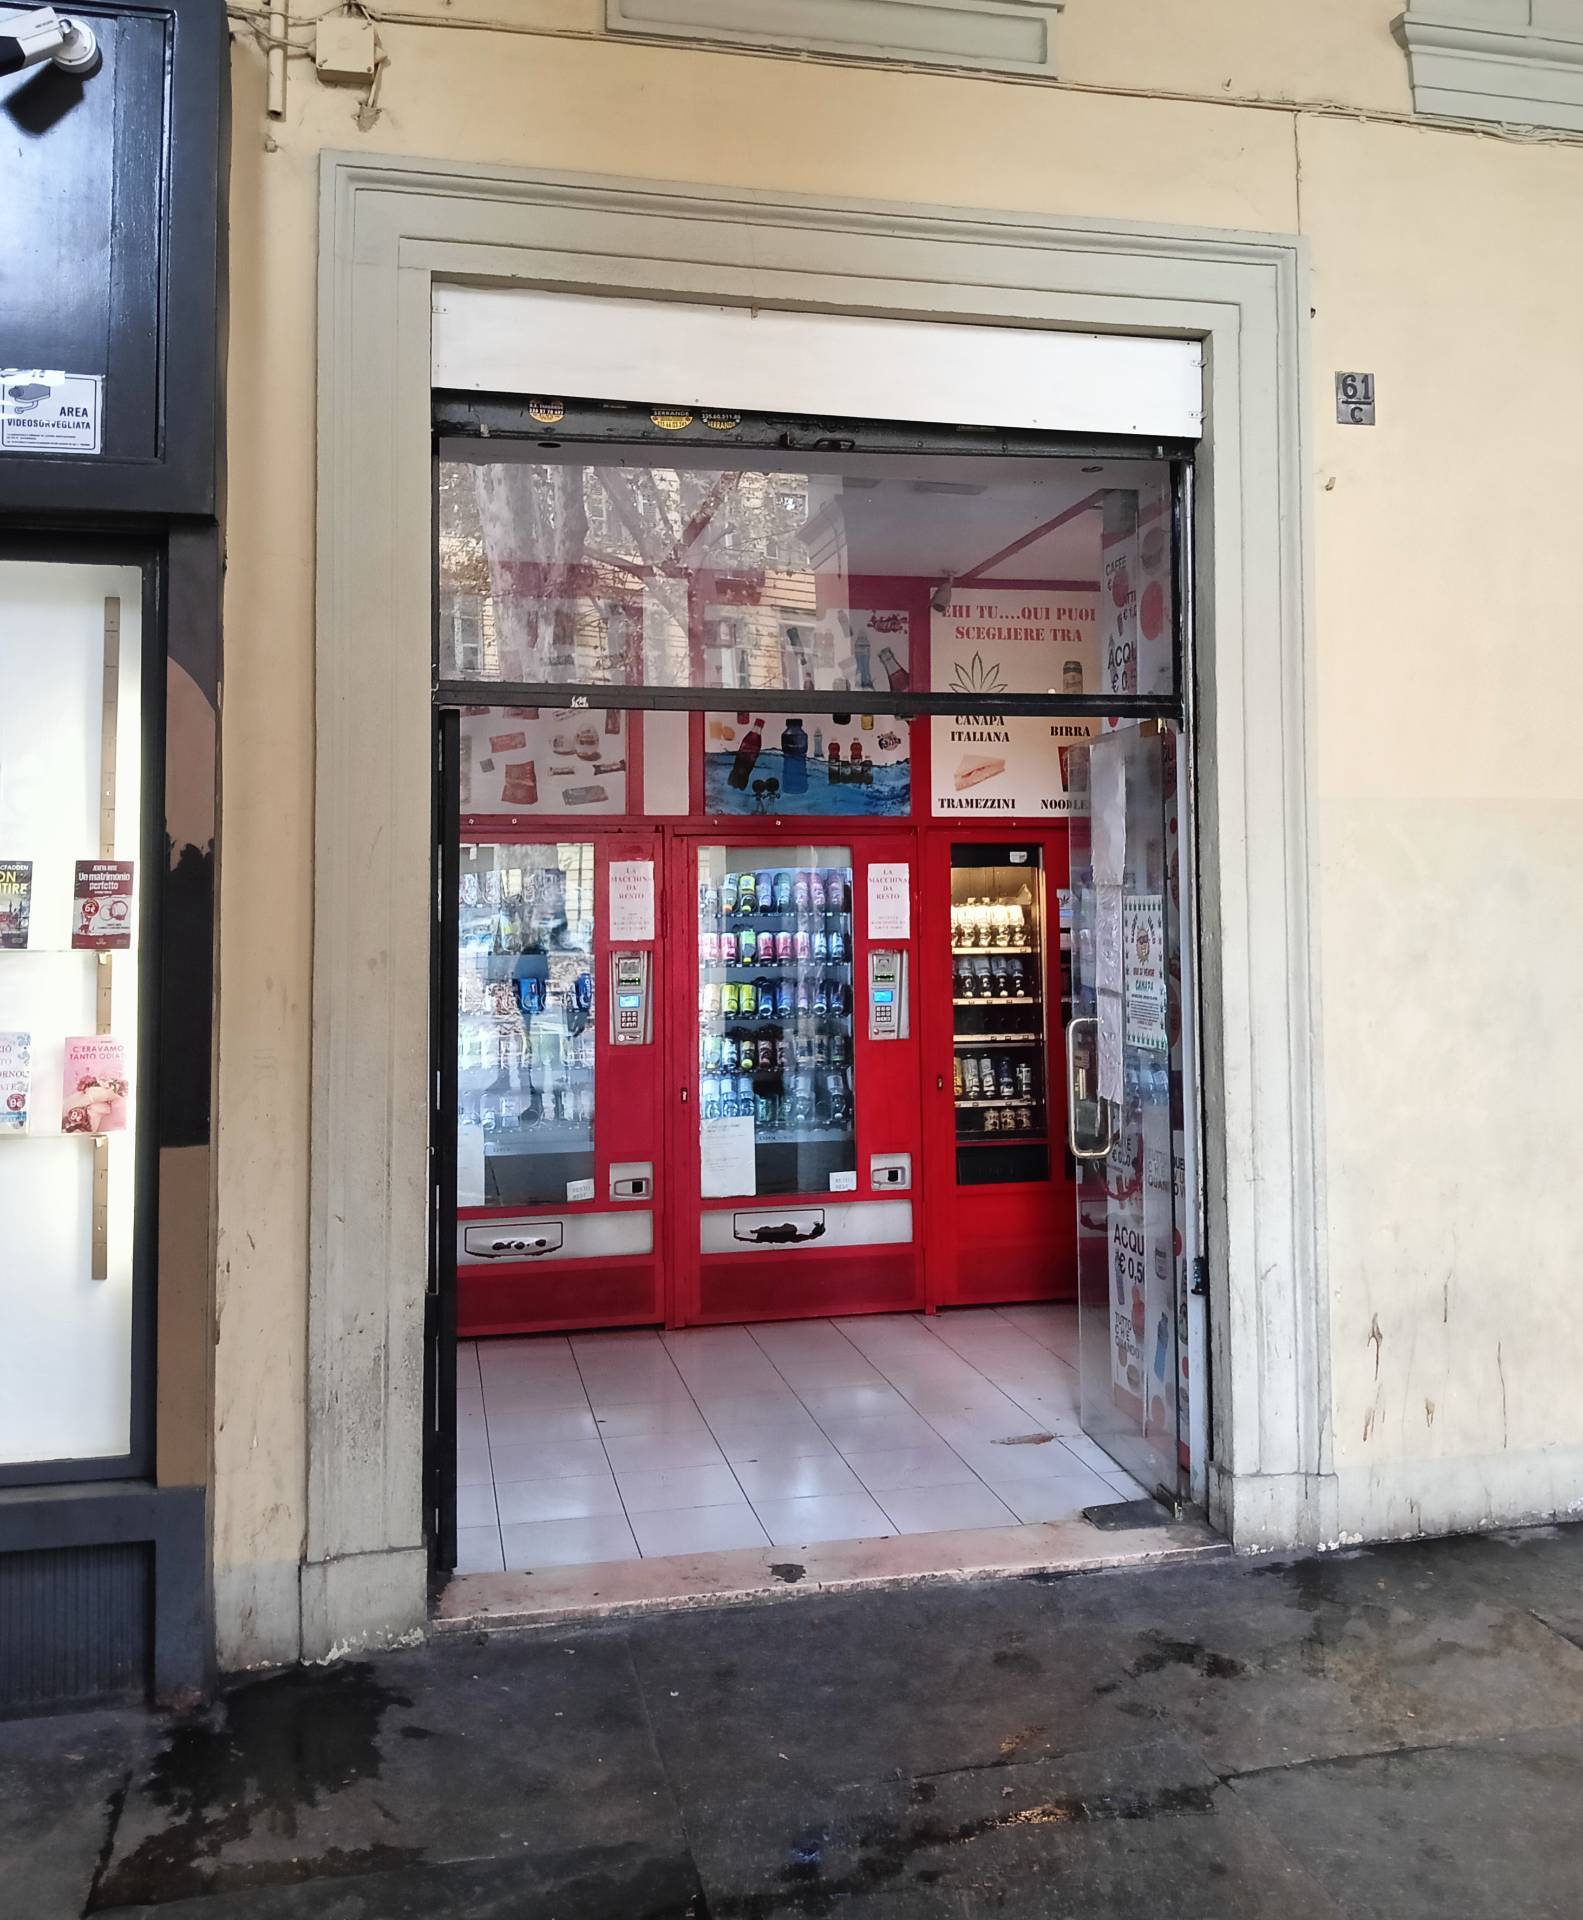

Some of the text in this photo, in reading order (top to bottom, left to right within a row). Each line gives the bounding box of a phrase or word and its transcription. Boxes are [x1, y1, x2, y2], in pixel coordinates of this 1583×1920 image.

[1342, 374, 1370, 399] 61
[60, 406, 88, 417] AREA
[1350, 406, 1363, 423] C
[7, 418, 91, 430] VIDEOSORVEGLIATA
[1056, 607, 1096, 621] PUOI
[955, 627, 1083, 642] SCEGLIERE TRA
[955, 715, 1004, 726] CANAPA
[951, 731, 1010, 742] ITALIANA
[1050, 726, 1090, 737] BIRRA
[938, 798, 1016, 809] TRAMEZZINI
[79, 872, 130, 881] Un matrimonio
[89, 881, 119, 891] perfetto
[70, 1053, 96, 1061] TANTO
